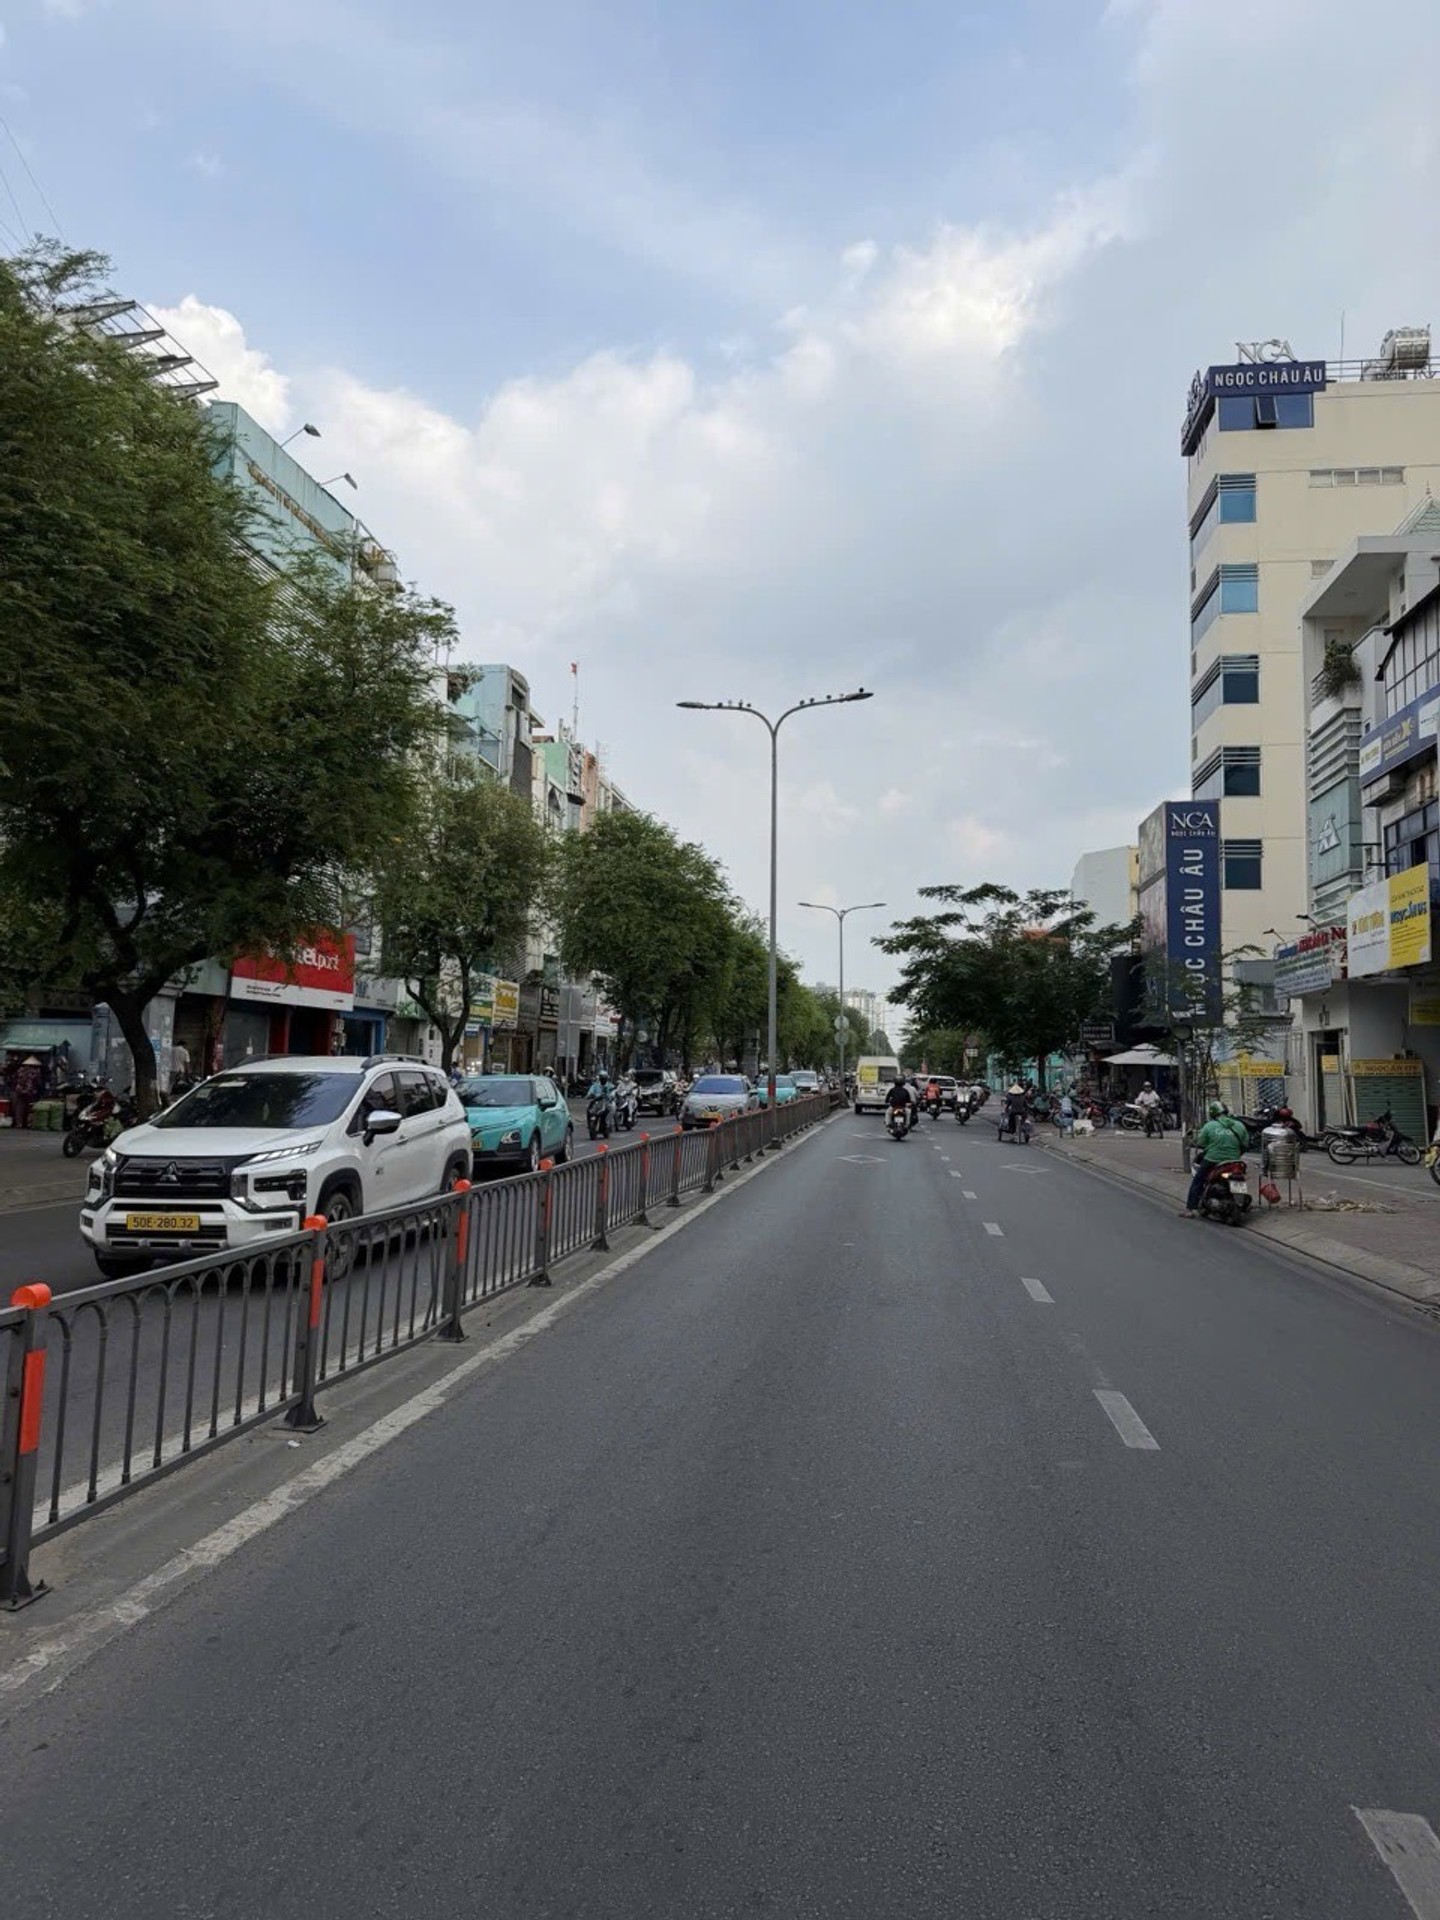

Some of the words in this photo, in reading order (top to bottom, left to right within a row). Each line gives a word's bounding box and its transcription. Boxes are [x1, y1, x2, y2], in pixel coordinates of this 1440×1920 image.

[1215, 371, 1254, 388] NGỌC
[1258, 367, 1299, 384] CHÂU
[1303, 366, 1323, 383] ÂU
[1179, 849, 1204, 876] ÂU
[1180, 888, 1205, 946] CHÂU
[133, 1216, 194, 1228] 50E-280.32
